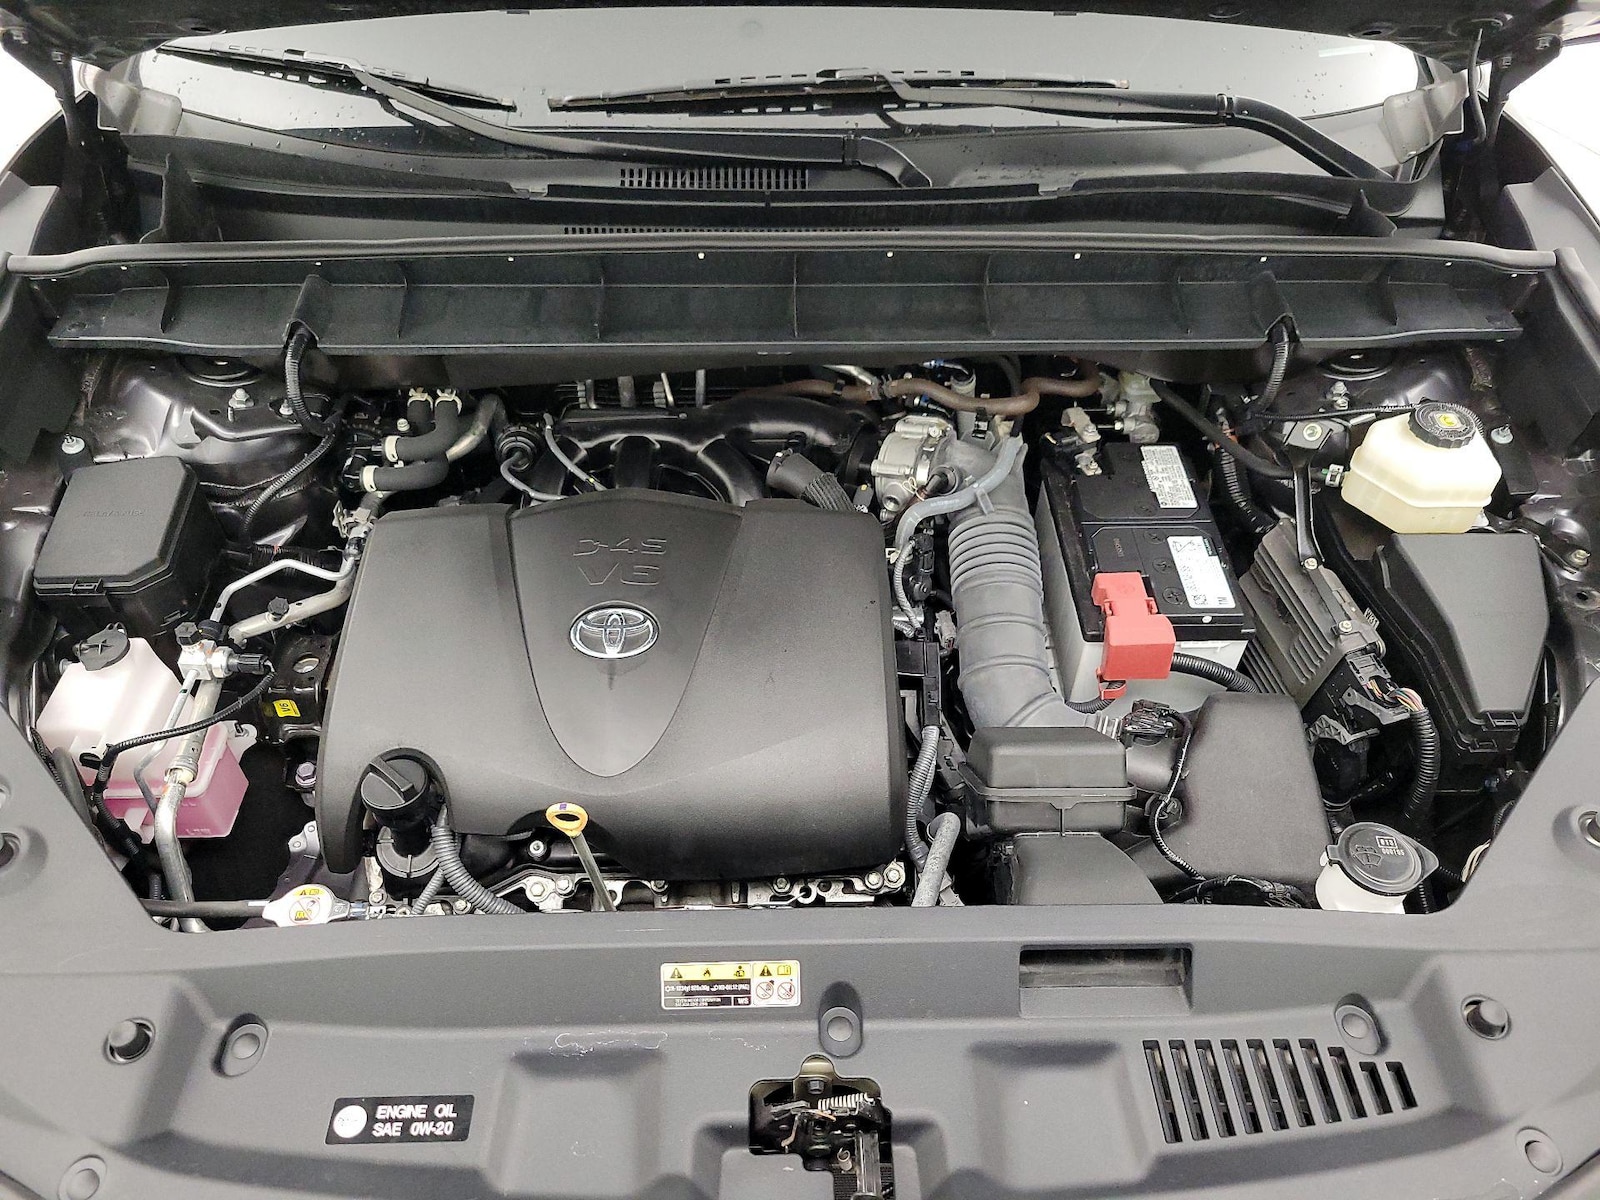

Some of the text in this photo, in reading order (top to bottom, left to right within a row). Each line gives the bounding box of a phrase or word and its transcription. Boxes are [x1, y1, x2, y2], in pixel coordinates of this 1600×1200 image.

[375, 1103, 458, 1120] ENGINE OIL
[371, 1121, 454, 1137] SAE 0W-20
